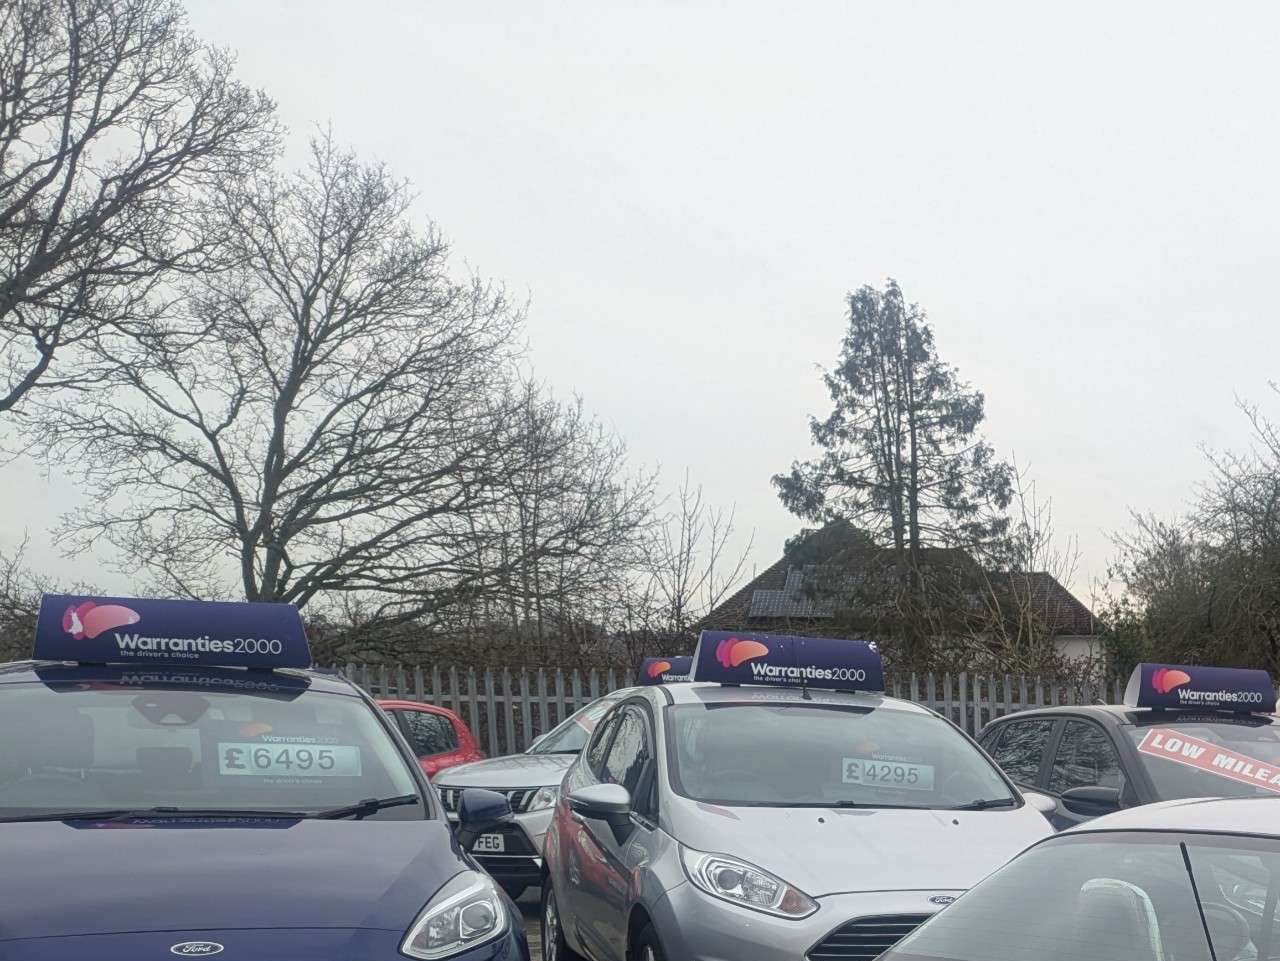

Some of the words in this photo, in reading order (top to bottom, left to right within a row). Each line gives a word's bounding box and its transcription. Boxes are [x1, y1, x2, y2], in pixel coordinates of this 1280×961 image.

[114, 632, 282, 655] Warranties2000
[137, 650, 169, 658] driver's
[171, 651, 200, 659] choice
[750, 662, 866, 682] Warranties2000
[1178, 688, 1263, 703] Warranties2000
[1150, 734, 1206, 759] LOW
[224, 747, 335, 770] £6495
[846, 762, 919, 784] £4295
[477, 835, 500, 849] FEG
[182, 943, 212, 953] Ford
